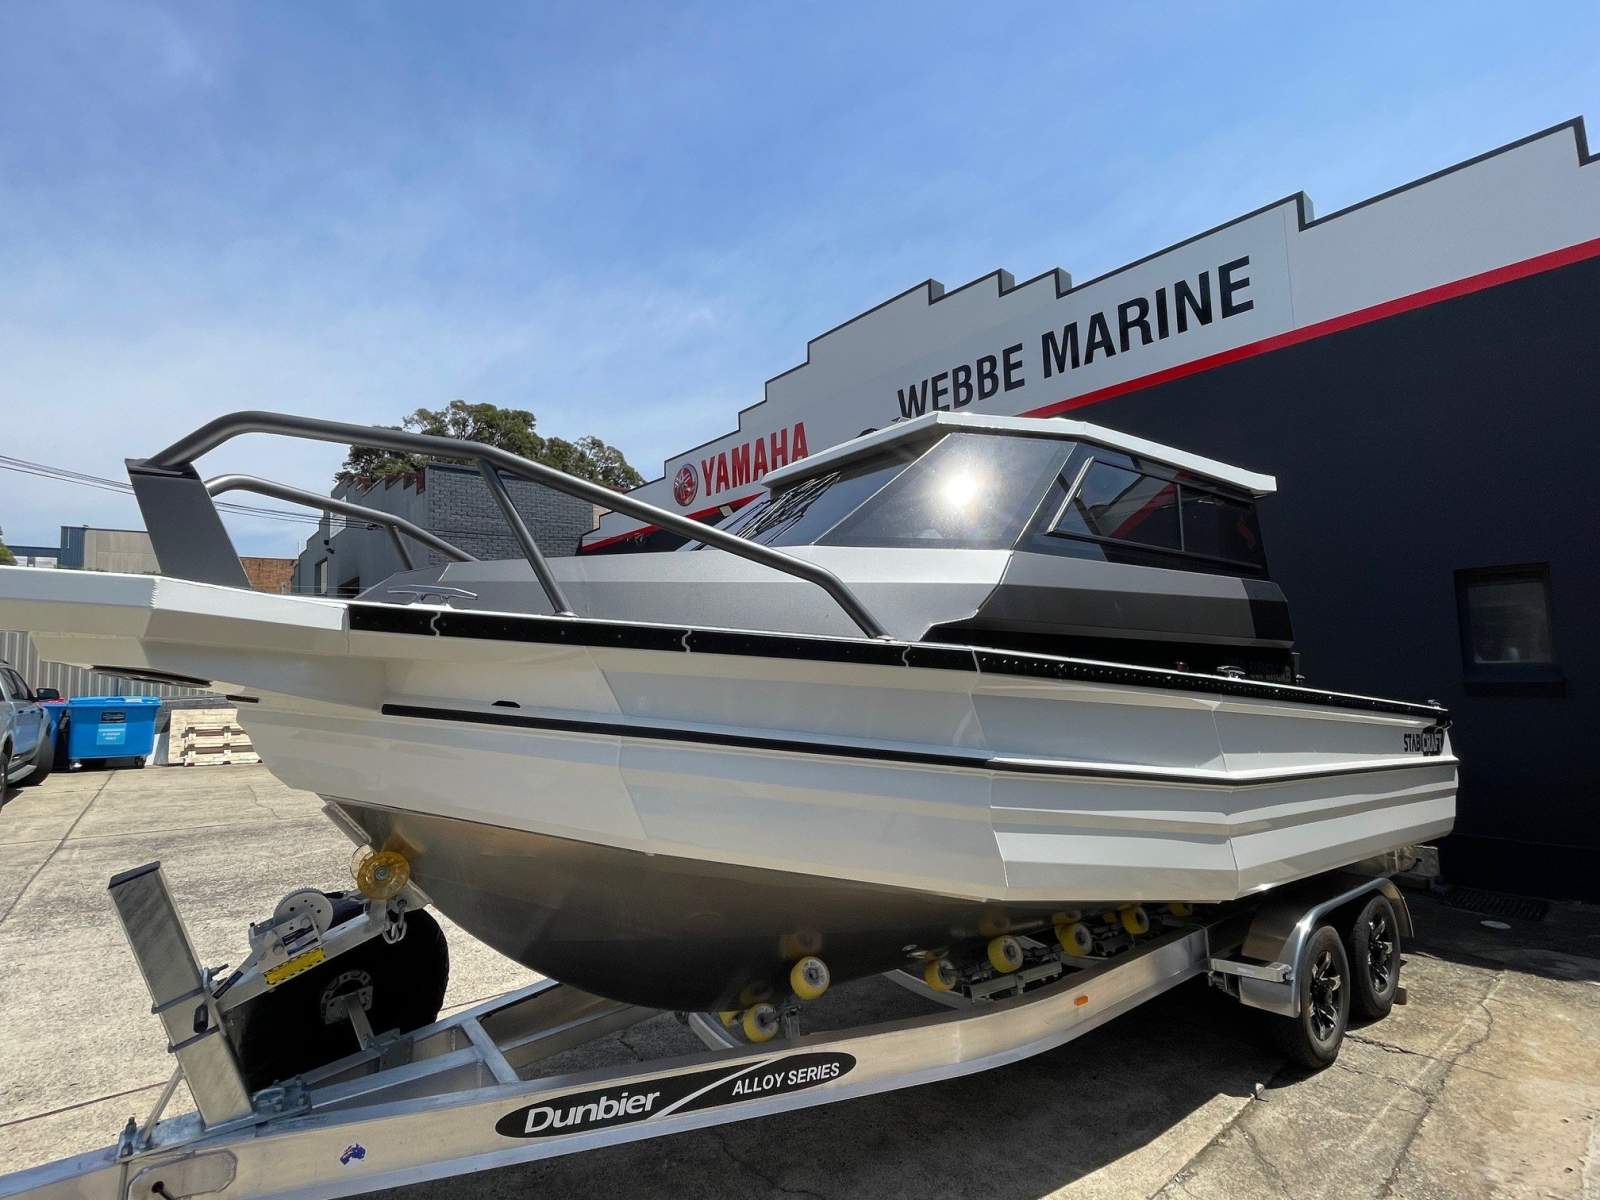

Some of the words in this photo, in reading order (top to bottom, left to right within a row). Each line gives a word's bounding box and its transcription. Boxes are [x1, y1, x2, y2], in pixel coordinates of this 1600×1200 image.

[897, 343, 1026, 419] WEBBE
[1041, 255, 1254, 379] MARINE
[701, 421, 809, 497] YAMAHA
[732, 1073, 784, 1096] ALLOY
[787, 1062, 841, 1086] SERIES
[524, 1089, 661, 1134] Dunbier
